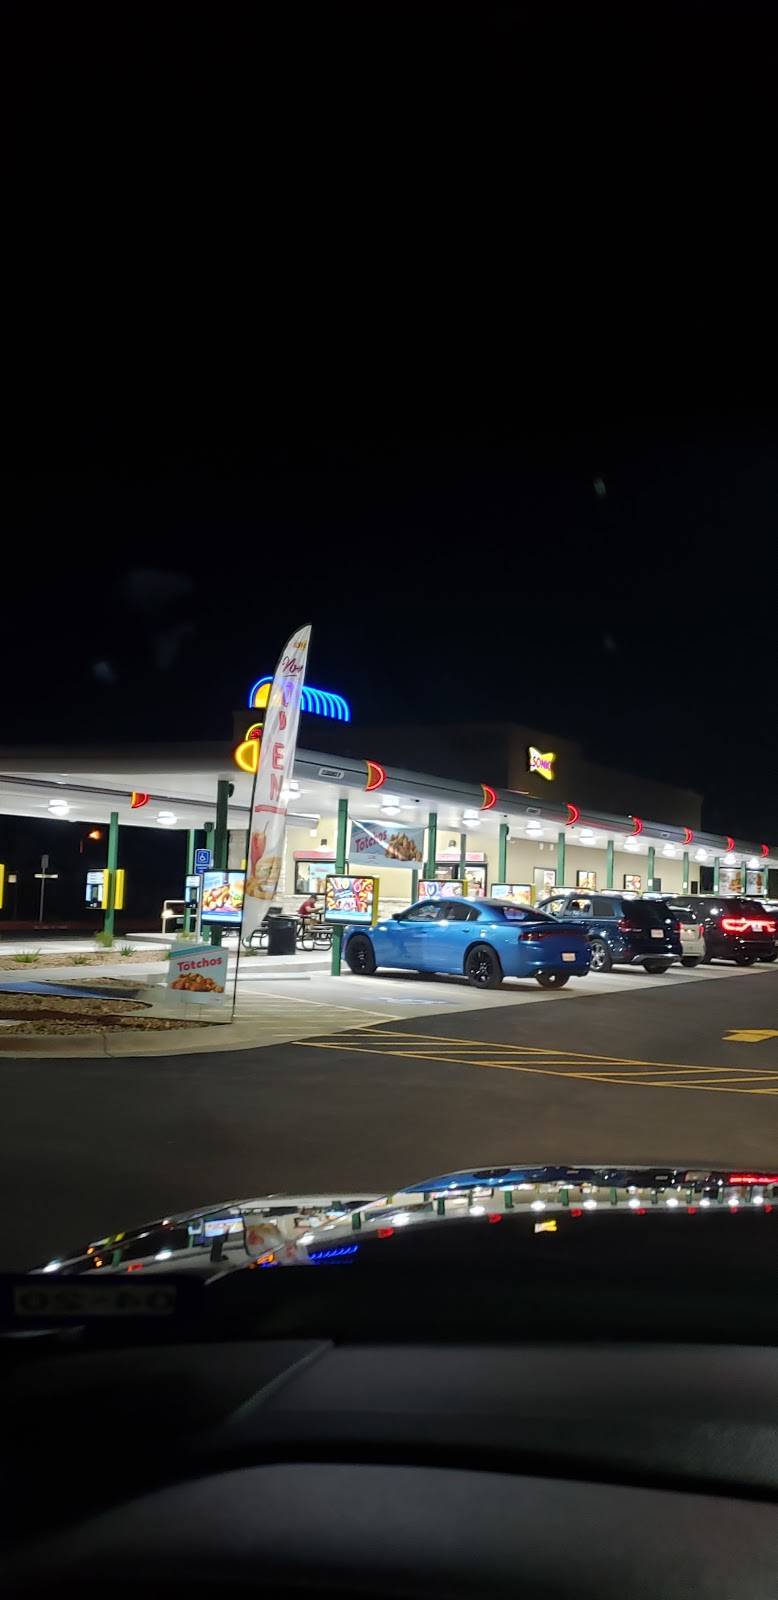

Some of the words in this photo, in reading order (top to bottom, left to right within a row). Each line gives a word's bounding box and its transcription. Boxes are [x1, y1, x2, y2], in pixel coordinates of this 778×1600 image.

[529, 755, 554, 771] SONIC
[355, 830, 388, 853] Totcos
[176, 956, 224, 972] Totchos
